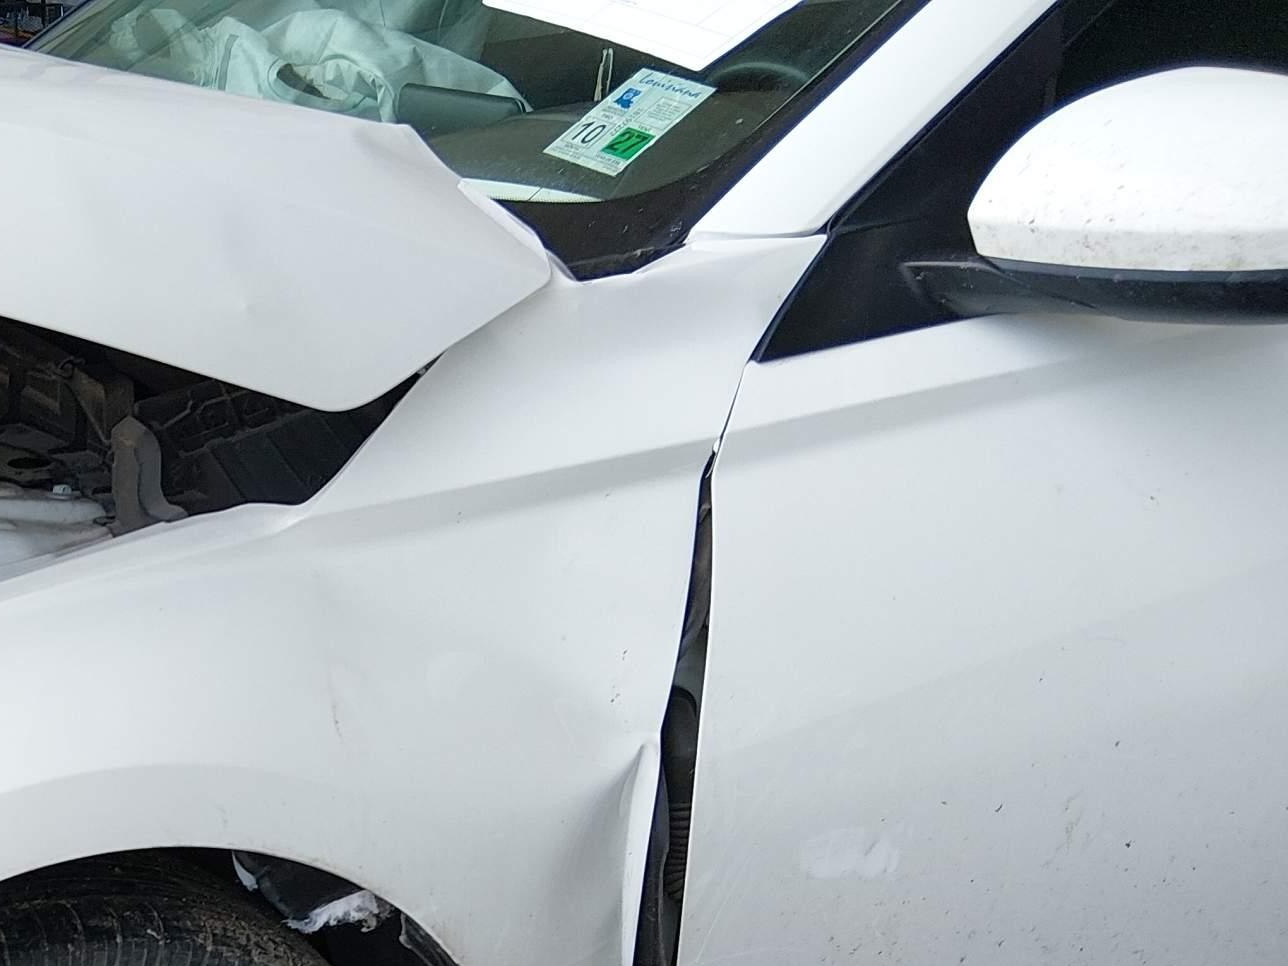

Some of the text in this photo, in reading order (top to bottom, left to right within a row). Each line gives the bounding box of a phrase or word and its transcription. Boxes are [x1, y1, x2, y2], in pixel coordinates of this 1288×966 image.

[638, 73, 702, 98] Louisiana
[571, 121, 607, 145] 10
[607, 130, 649, 154] 27
